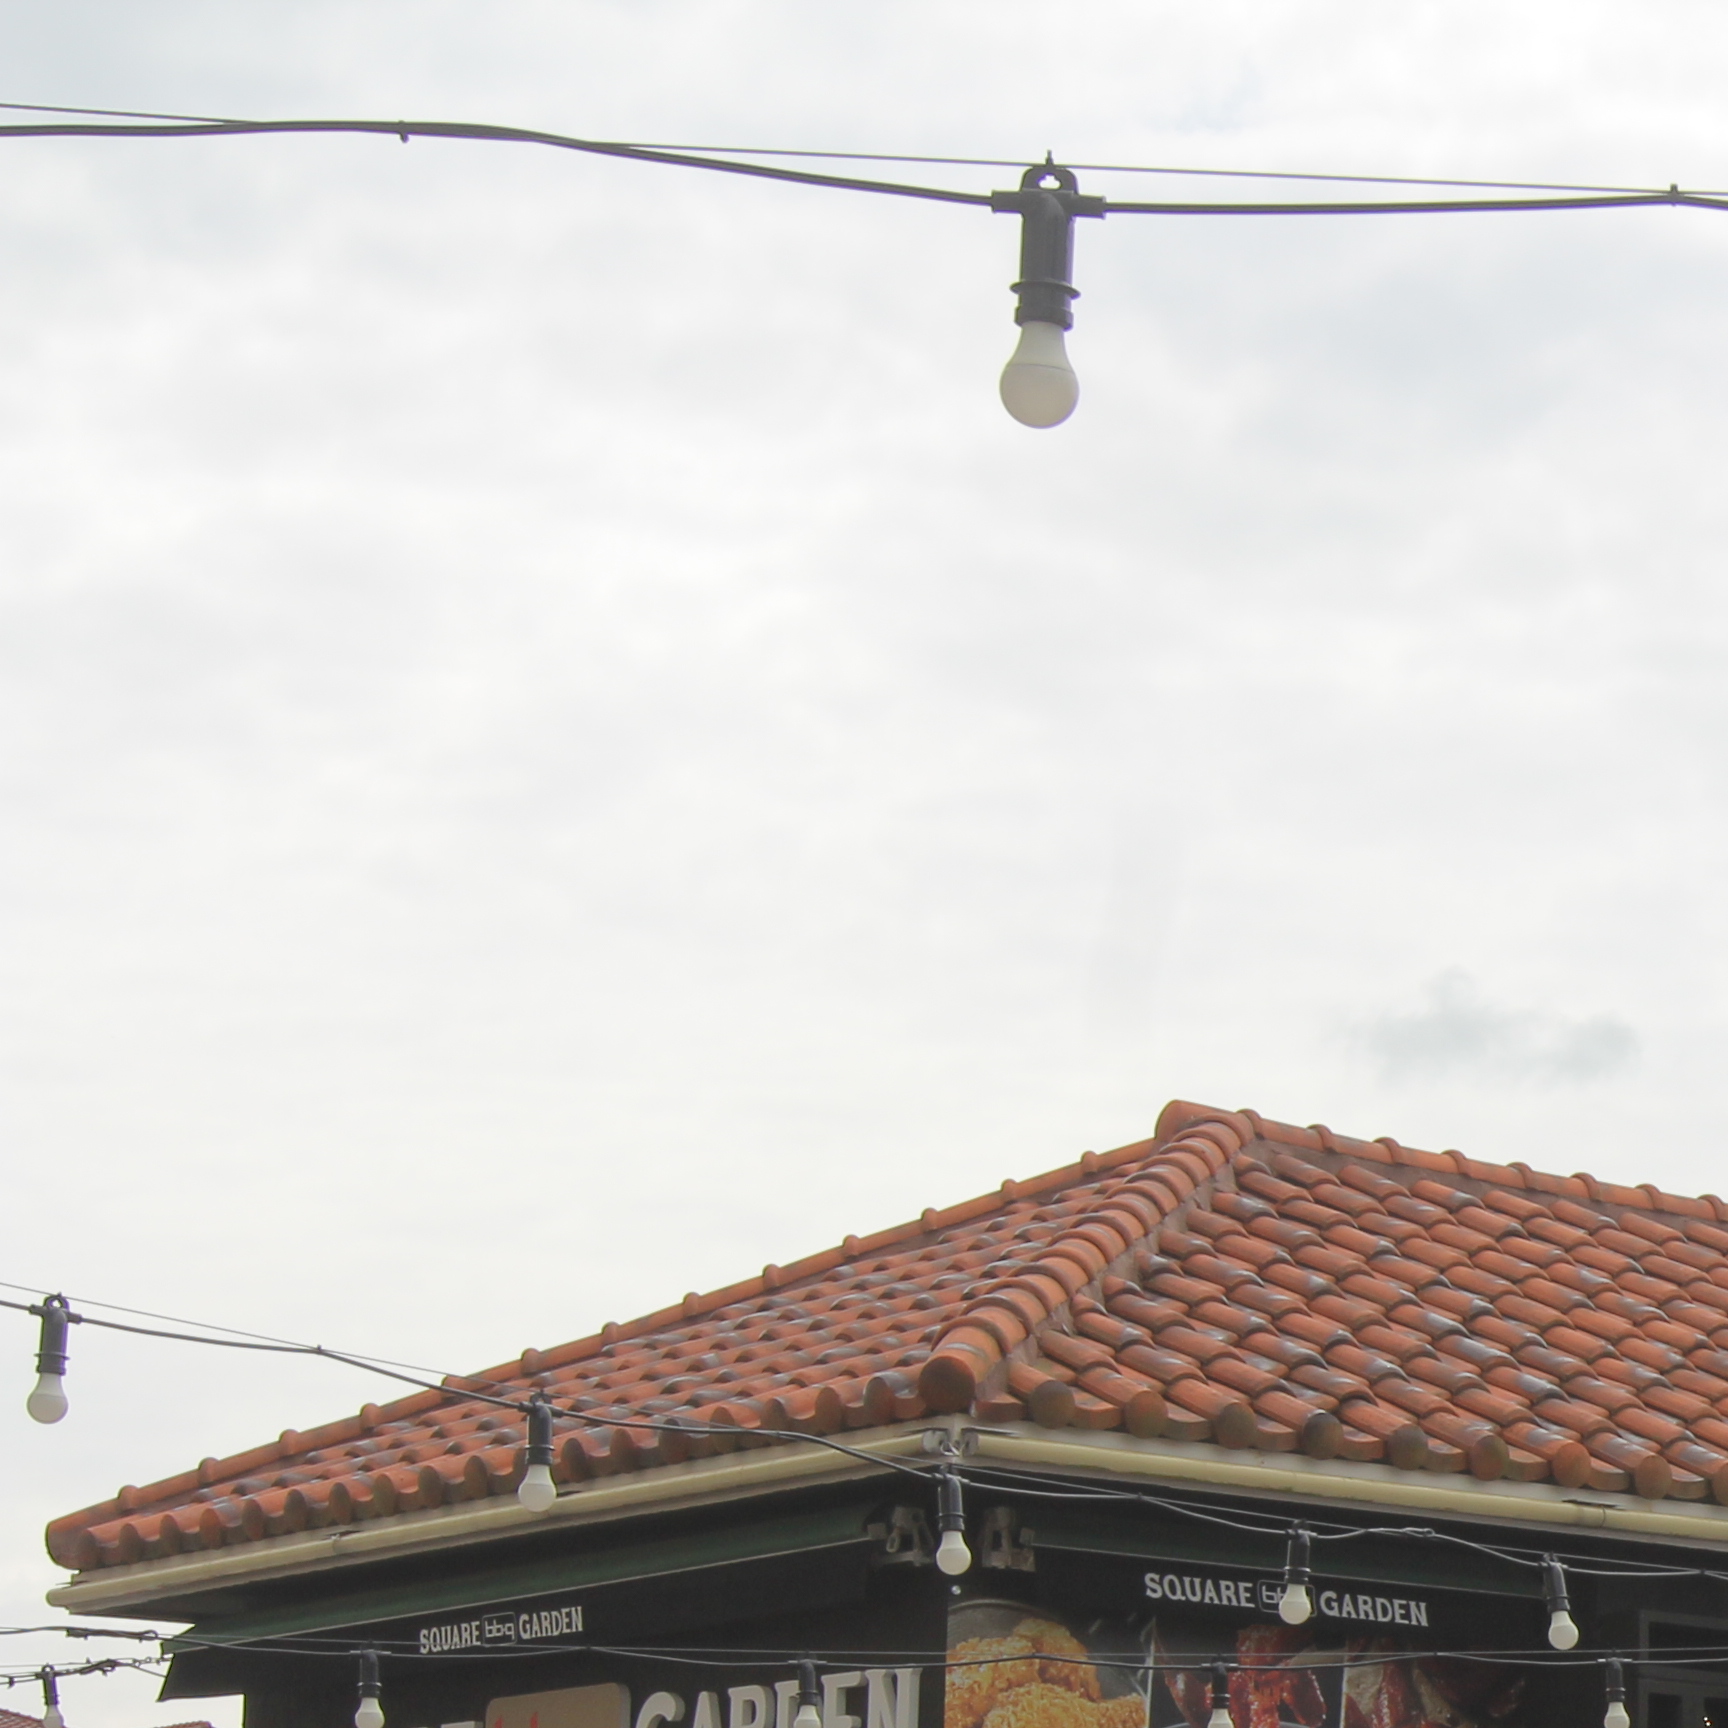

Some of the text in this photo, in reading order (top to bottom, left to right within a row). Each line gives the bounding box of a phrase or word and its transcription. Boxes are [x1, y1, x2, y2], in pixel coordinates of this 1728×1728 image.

[1144, 1573, 1255, 1607] SQUARE
[1320, 1591, 1428, 1627] GARDEN
[420, 1620, 481, 1654] SQUARE
[519, 1606, 583, 1639] GARDEN
